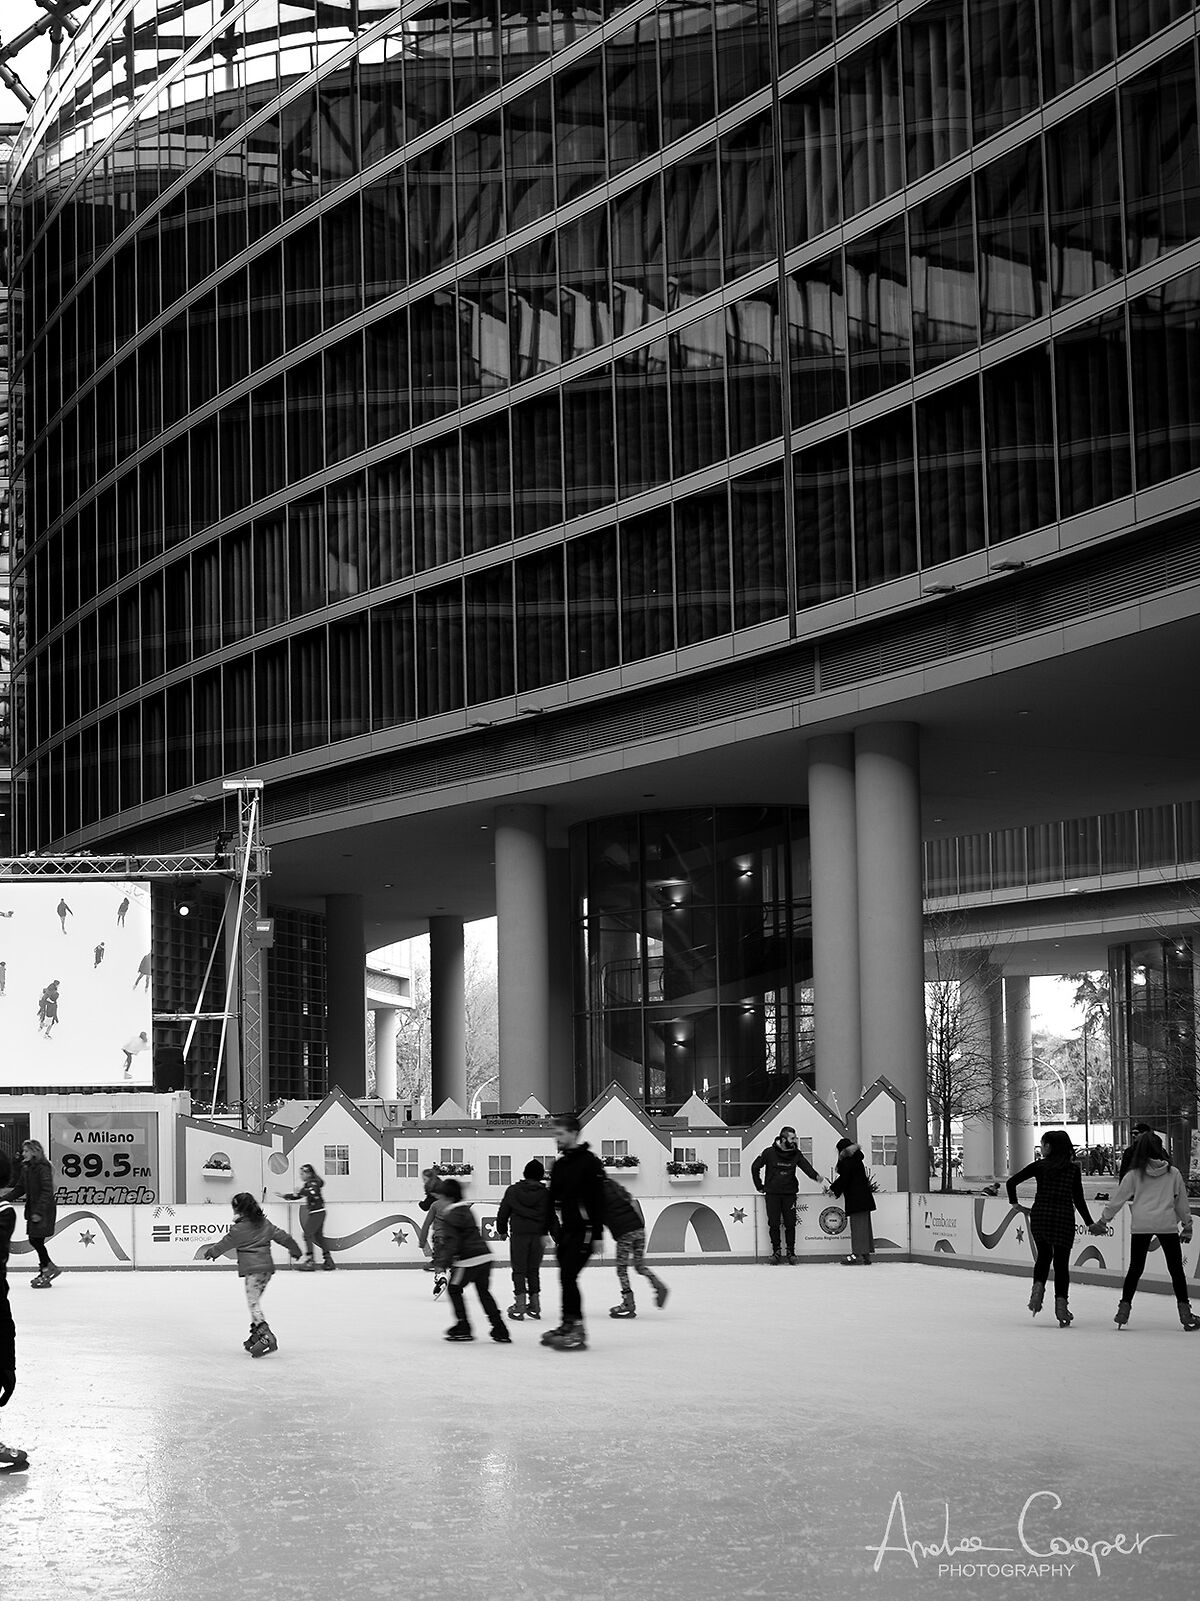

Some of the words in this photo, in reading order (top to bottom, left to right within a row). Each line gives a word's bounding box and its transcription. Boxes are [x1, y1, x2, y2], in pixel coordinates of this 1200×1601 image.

[73, 1131, 84, 1143] A
[87, 1130, 134, 1143] Milano
[62, 1153, 131, 1178] 89.5
[133, 1167, 151, 1177] FM
